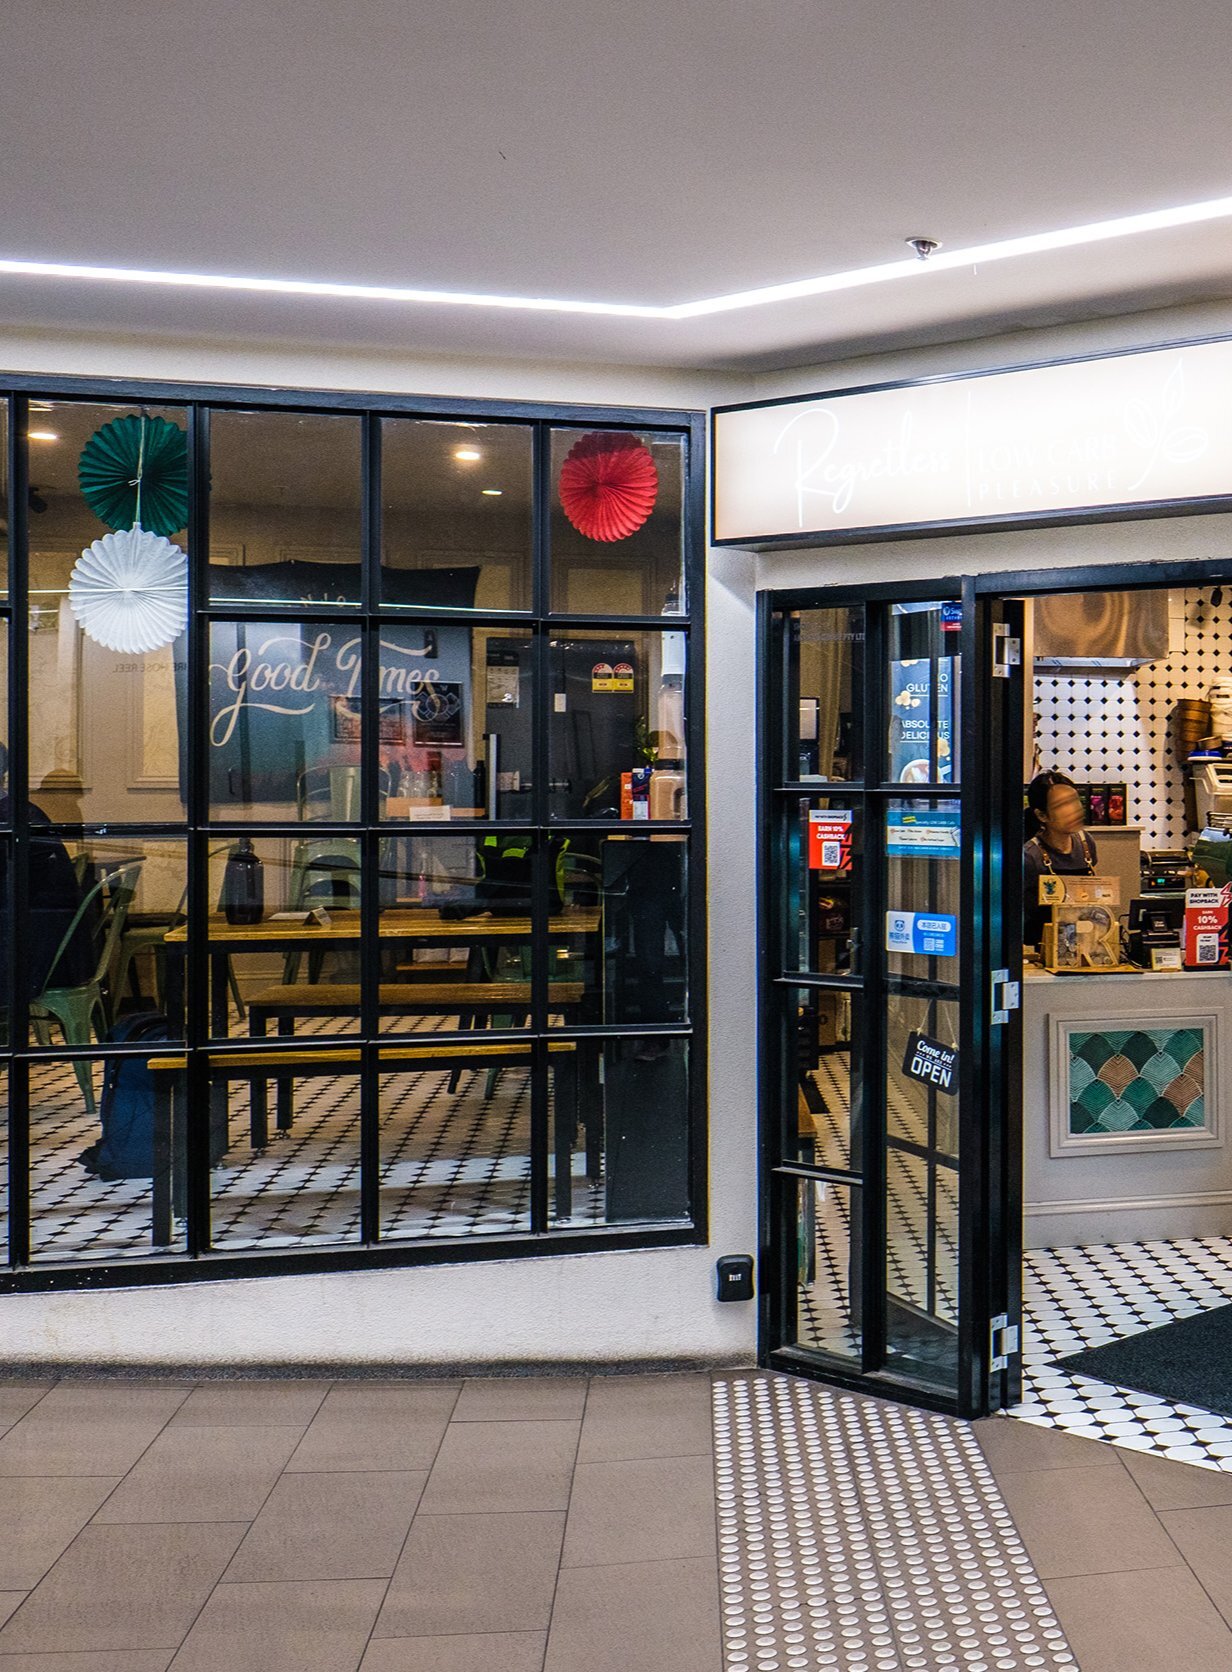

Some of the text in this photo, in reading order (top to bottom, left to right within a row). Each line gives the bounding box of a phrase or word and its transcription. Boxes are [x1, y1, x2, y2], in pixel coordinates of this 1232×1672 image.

[774, 408, 952, 526] Regretless
[977, 432, 1117, 474] LOW CARB
[979, 468, 1118, 501] PLEASURE
[209, 632, 441, 747] Good Tmes
[906, 683, 948, 693] GLUEN
[1197, 915, 1219, 924] 10%
[917, 1040, 956, 1064] Come in!
[911, 1056, 952, 1088] OPEN
